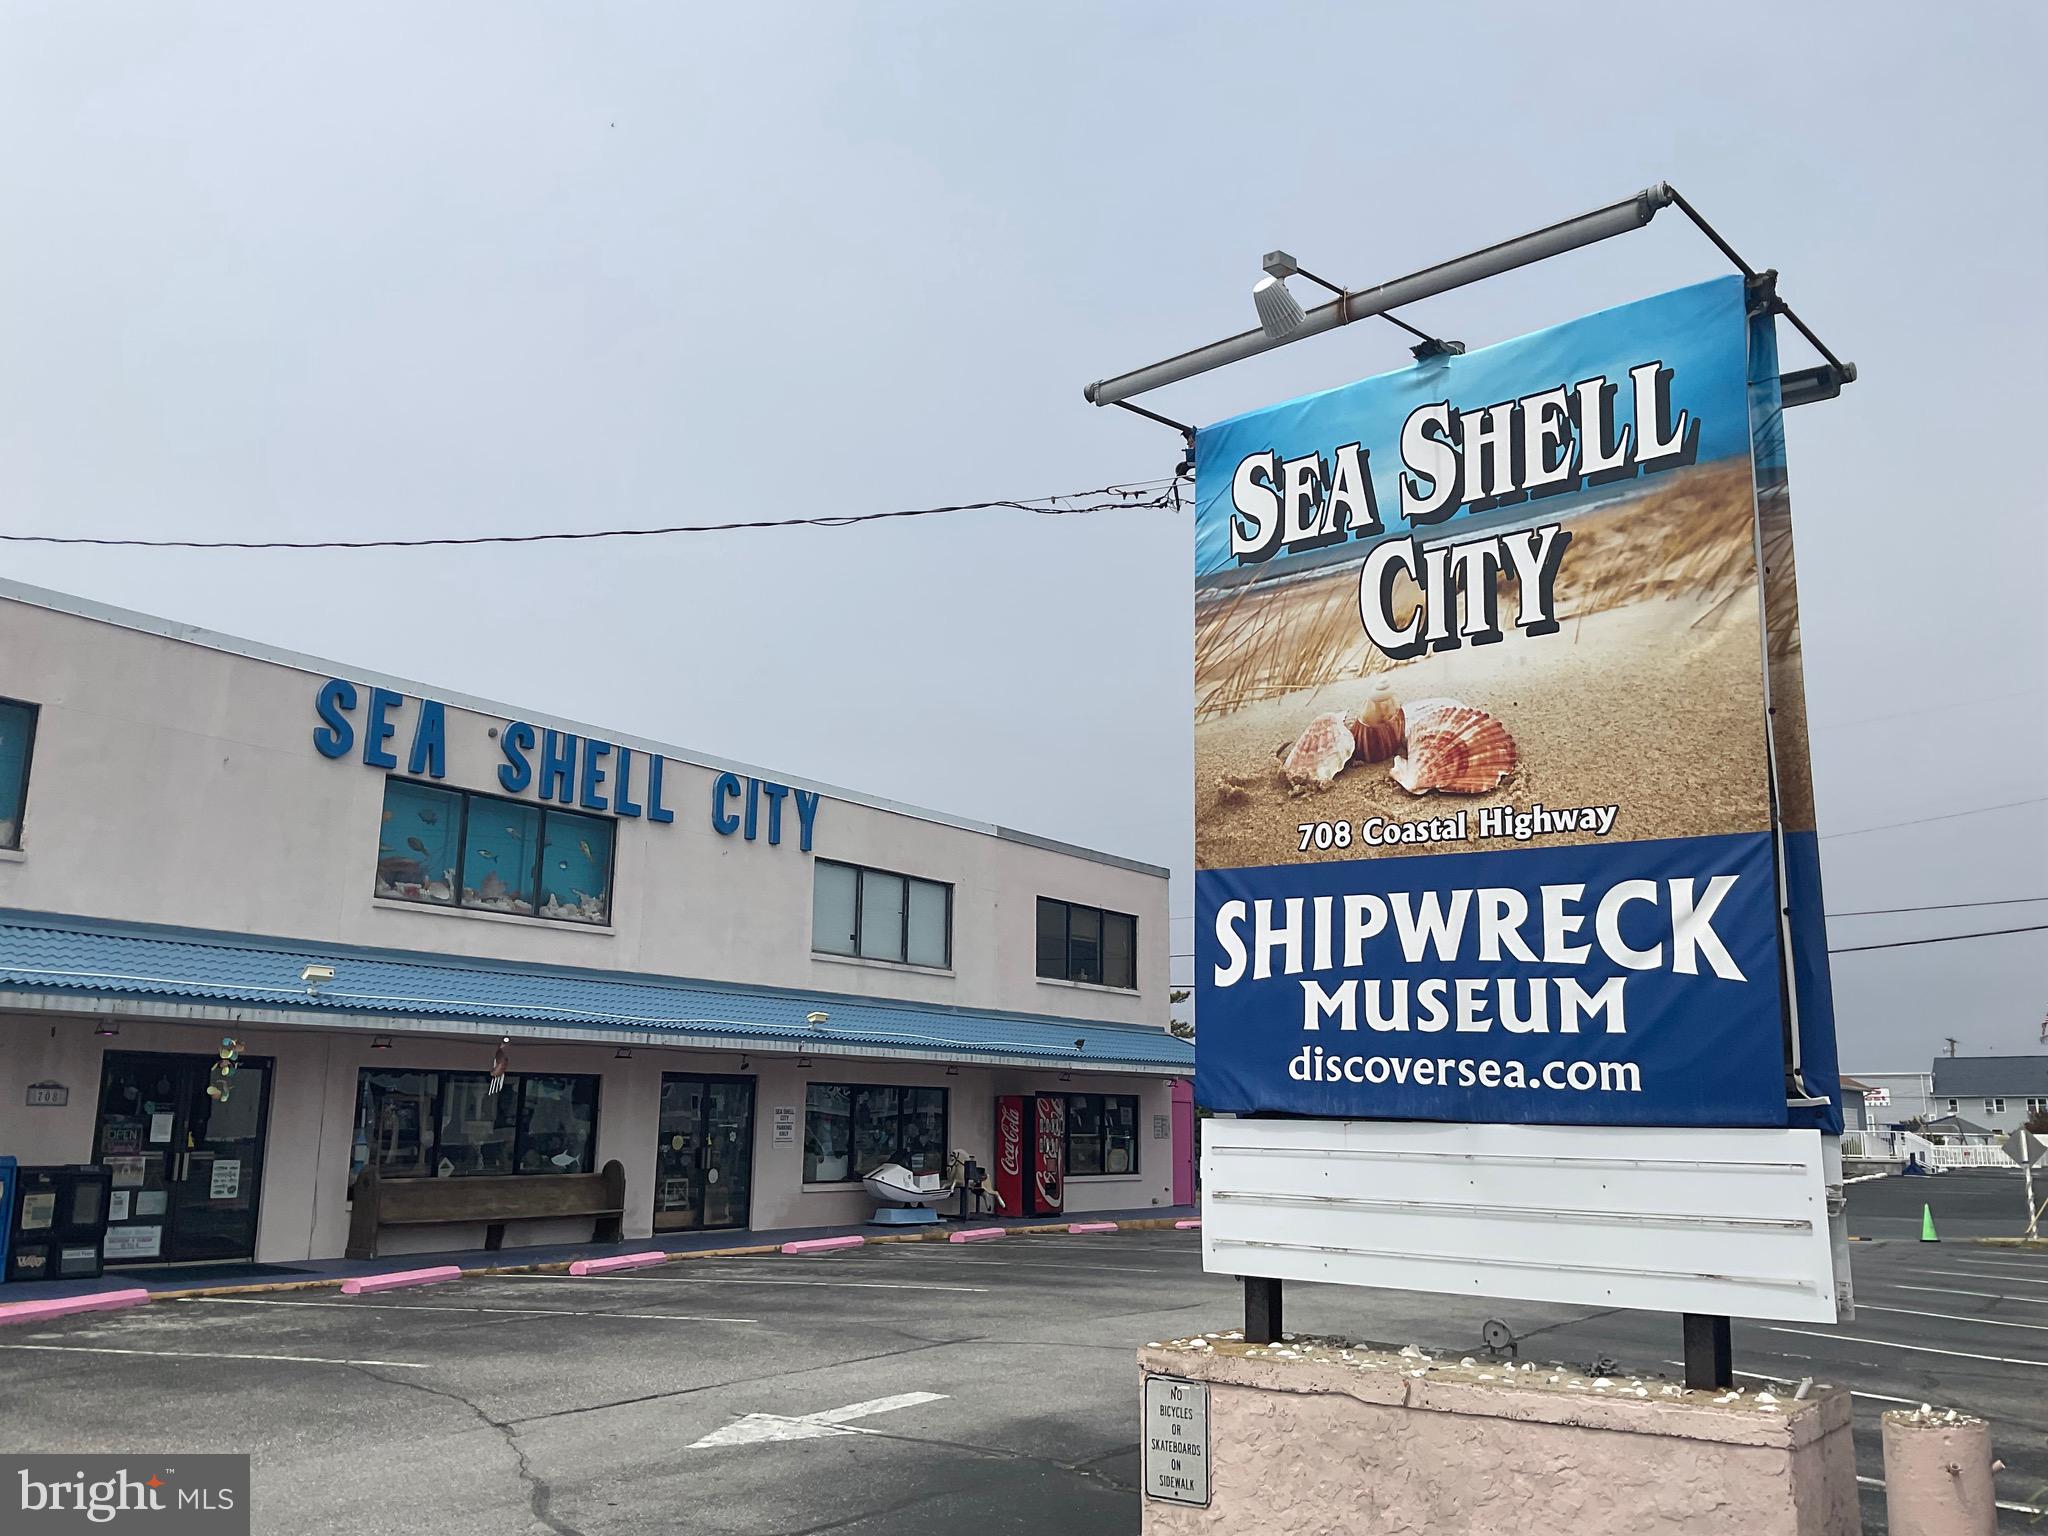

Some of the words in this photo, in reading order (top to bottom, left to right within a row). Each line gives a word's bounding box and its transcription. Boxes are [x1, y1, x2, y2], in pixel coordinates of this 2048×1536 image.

[1229, 441, 1384, 566] SEA
[1398, 360, 1700, 526] SHELL
[1359, 522, 1572, 661] CITY
[313, 678, 446, 779] SEA
[497, 720, 675, 824] SHELL
[712, 771, 820, 852] CITY
[1297, 822, 1352, 853] 708
[1361, 809, 1468, 848] Coastal
[1477, 803, 1620, 842] Highway
[1213, 874, 1748, 988] SHIPWRECK
[1299, 976, 1628, 1034] MUSEUM
[1288, 1046, 1643, 1093] discoversea.com
[38, 1091, 58, 1102] 708
[109, 1129, 138, 1140] OPEN
[1170, 1389, 1182, 1401] NO
[1159, 1405, 1193, 1420] BICYCLES
[1171, 1424, 1181, 1435] OR
[1151, 1438, 1201, 1456] SKATEBOARDS
[1171, 1459, 1181, 1471] ON
[1159, 1474, 1195, 1491] SIDEWALK
